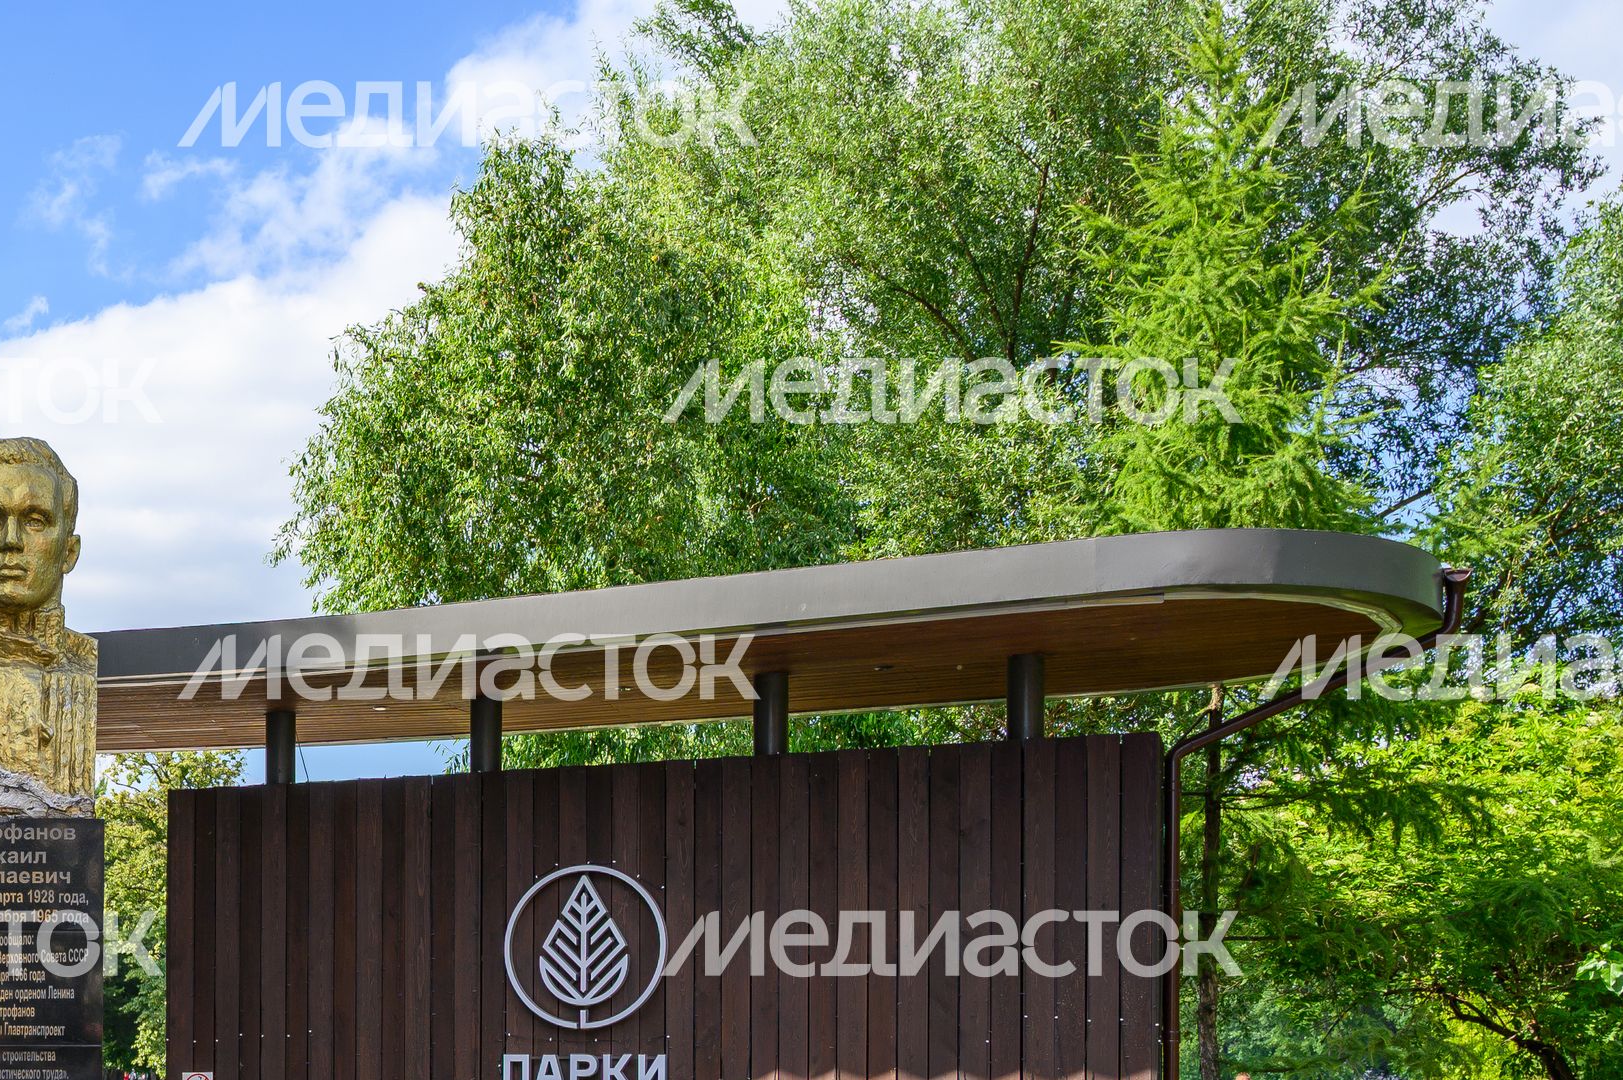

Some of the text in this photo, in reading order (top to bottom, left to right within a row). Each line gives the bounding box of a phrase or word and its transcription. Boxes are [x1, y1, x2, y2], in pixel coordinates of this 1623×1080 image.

[27, 890, 55, 903] 1928
[58, 892, 89, 906] года,
[31, 909, 58, 923] 1965
[62, 912, 89, 924] года
[40, 949, 67, 963] Совета
[68, 948, 89, 962] СССР
[28, 970, 46, 984] года
[14, 988, 46, 1002] орденом
[47, 986, 75, 1000] Ленина
[3, 1022, 66, 1039] Главтранспроект
[2, 1049, 56, 1064] строительства
